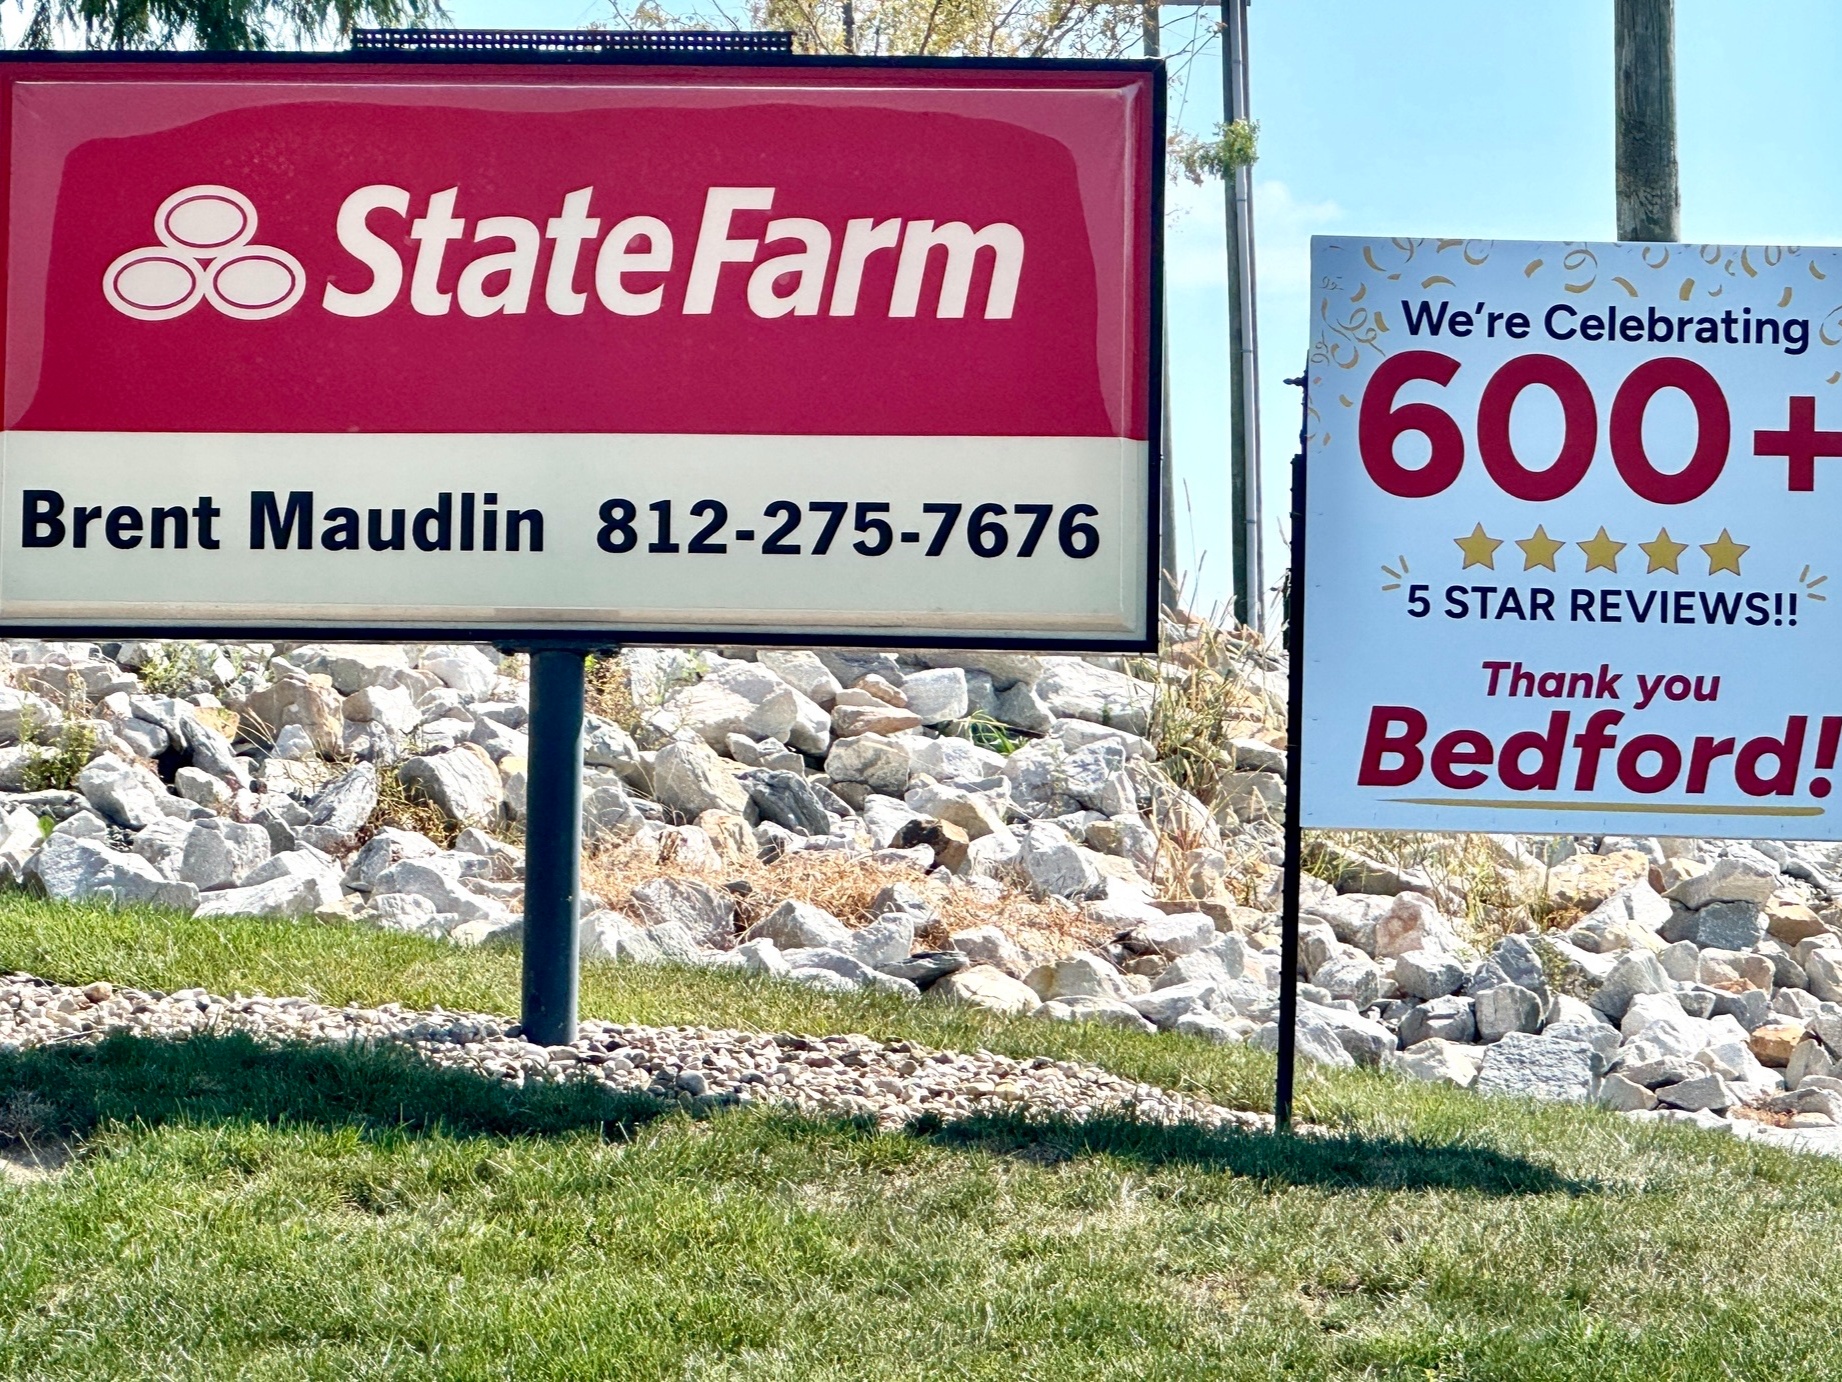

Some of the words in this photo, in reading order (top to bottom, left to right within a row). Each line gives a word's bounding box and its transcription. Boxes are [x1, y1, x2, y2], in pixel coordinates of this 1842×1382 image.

[1401, 299, 1531, 340] We're
[1544, 304, 1810, 355] Celebrating
[1358, 349, 1842, 505] 600+
[21, 489, 221, 550] Brent
[249, 490, 545, 552] Maudlin
[596, 498, 1101, 560] 812-275-7676
[1407, 584, 1431, 618] 5
[1444, 585, 1556, 622] STAR
[1570, 588, 1798, 627] REVIEWS!!
[1481, 661, 1624, 699] Thank
[1633, 674, 1721, 710] you
[1357, 705, 1842, 799] Bedford!
